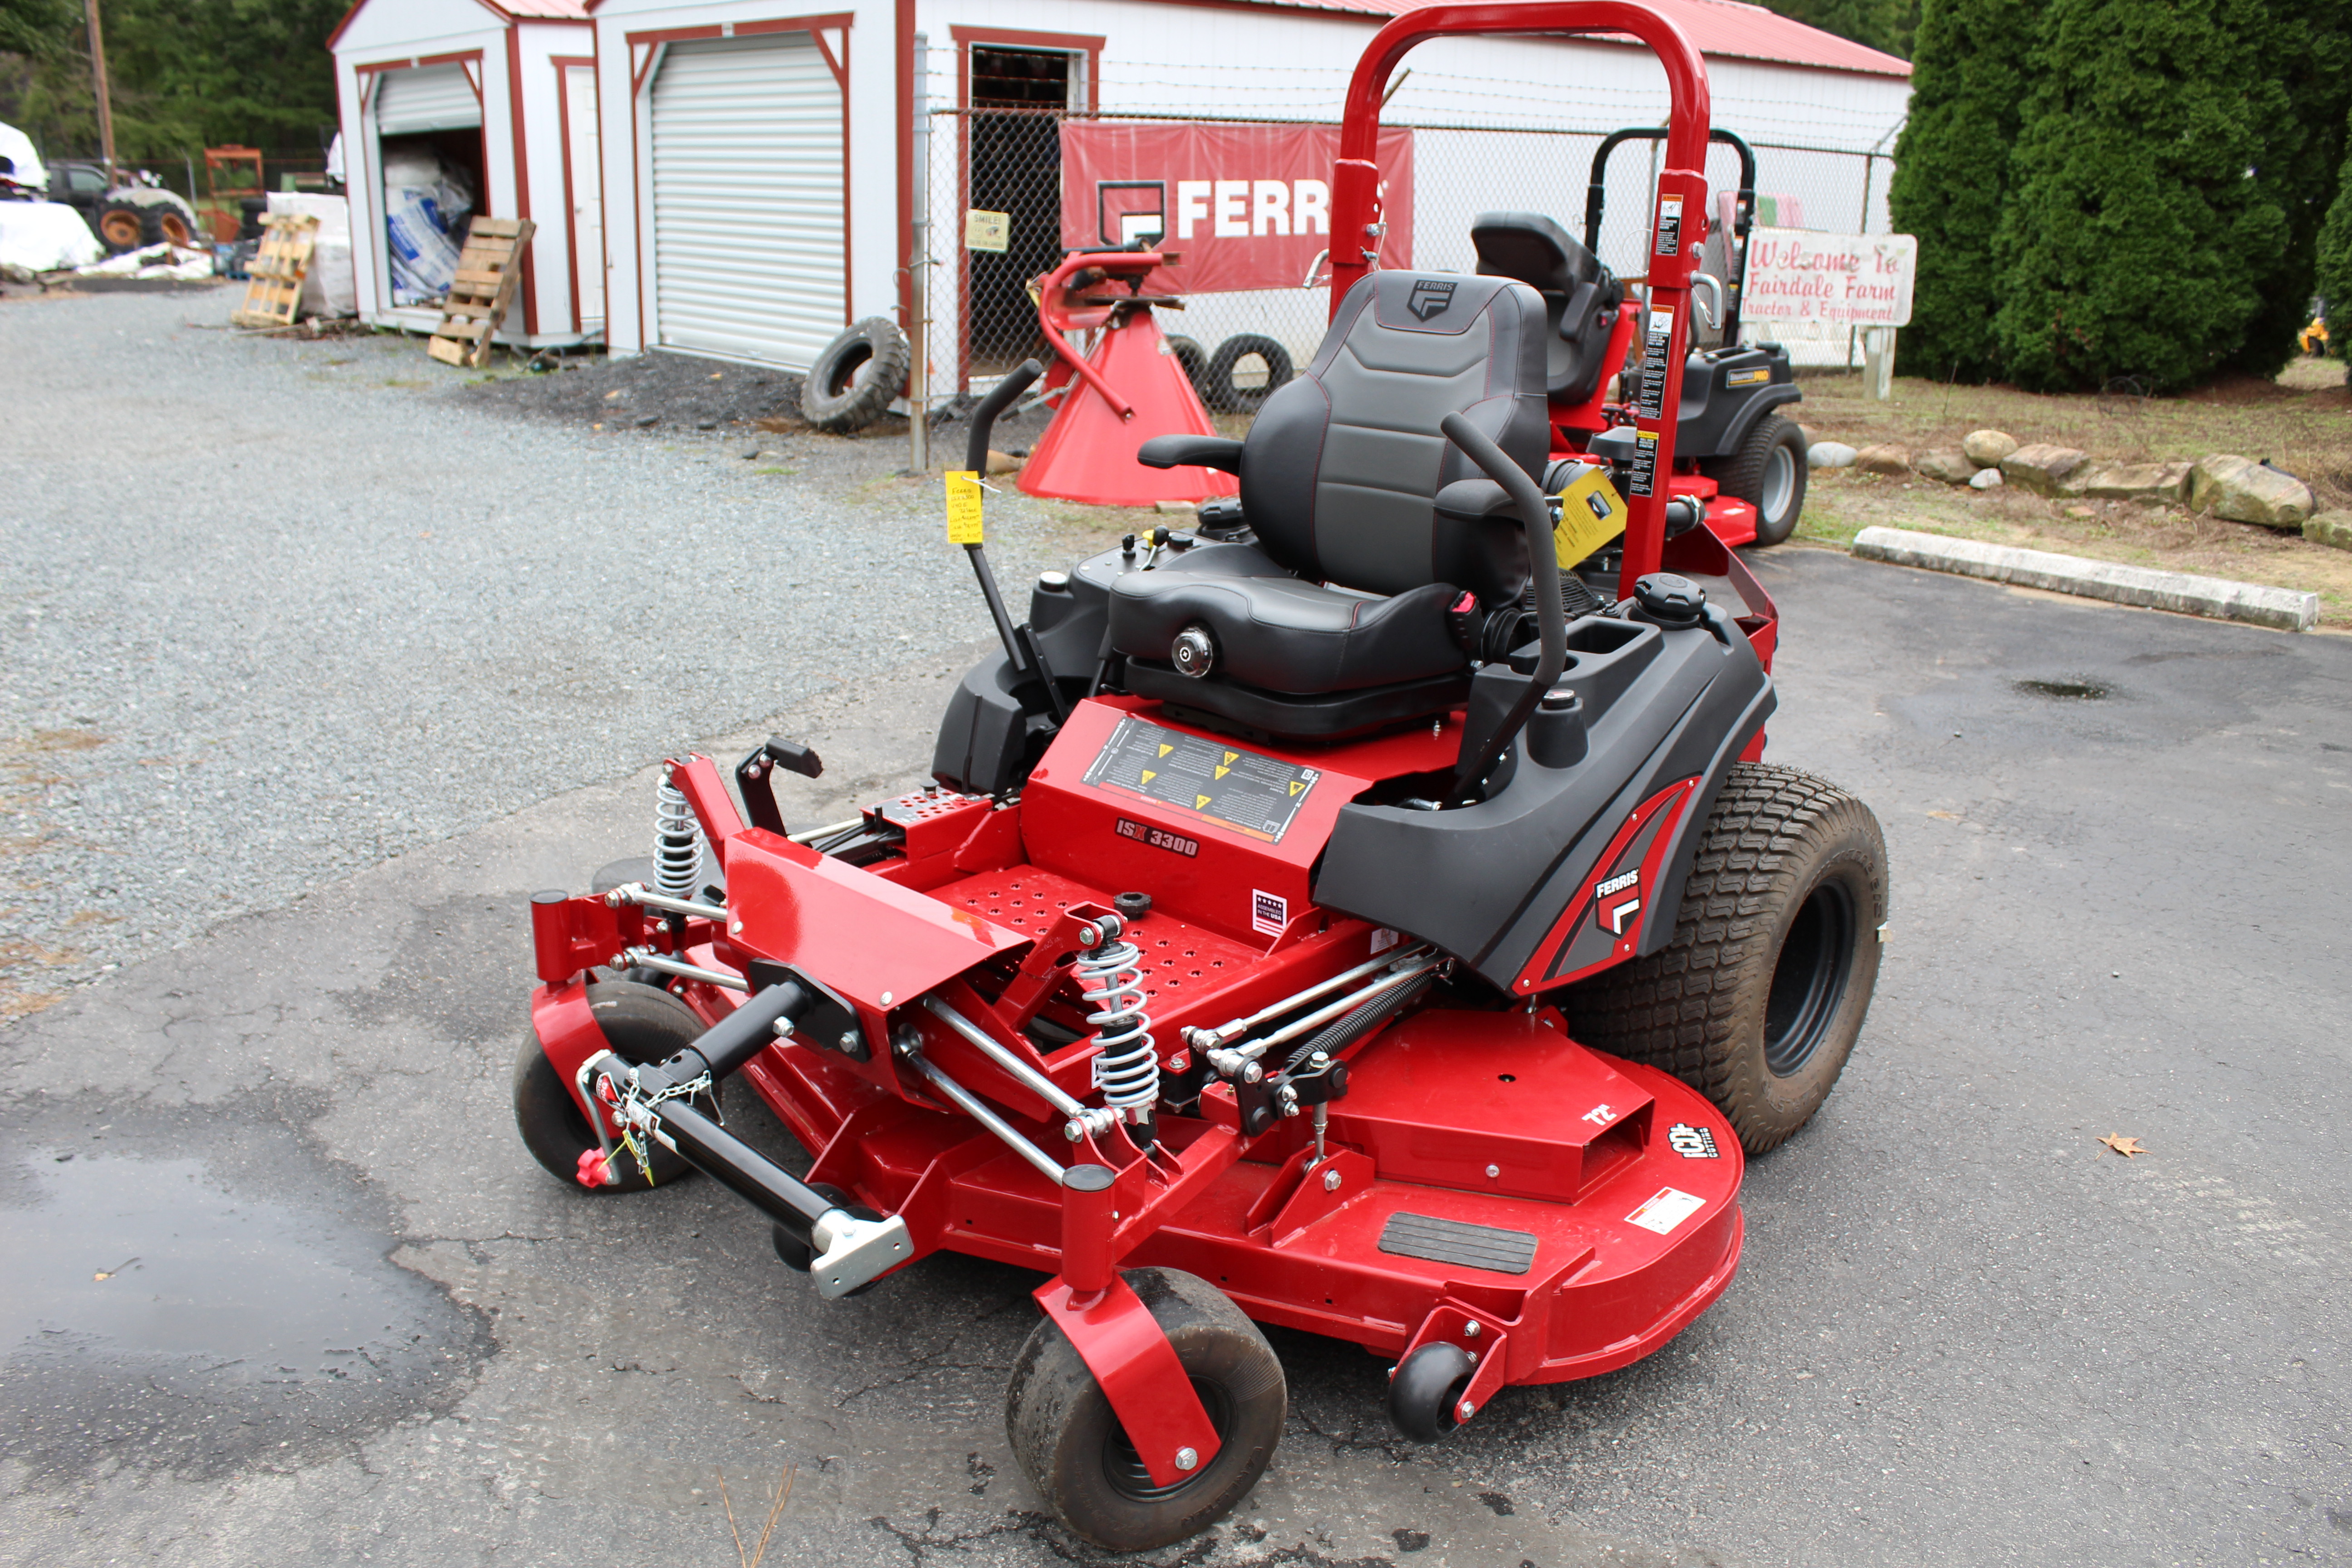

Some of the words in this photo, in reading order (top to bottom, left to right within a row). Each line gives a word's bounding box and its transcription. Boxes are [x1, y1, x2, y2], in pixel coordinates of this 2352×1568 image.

[974, 214, 1000, 224] SMILE!
[1751, 240, 1860, 272] Welcome
[1874, 245, 1899, 274] To
[1417, 281, 1454, 290] FERRIS
[1749, 271, 1833, 298] Fairdale
[1845, 275, 1895, 301] Farm
[1742, 297, 1792, 316] Tractor
[1800, 300, 1810, 316] &
[1820, 301, 1892, 322] Equipment
[1754, 369, 1769, 382] PRO
[1117, 819, 1147, 842] ISX
[1150, 830, 1198, 856] 3300
[1597, 869, 1638, 898] FERRIS
[1257, 904, 1282, 916] ASSEMBLED
[1270, 913, 1282, 921] USA
[1581, 1104, 1617, 1126] 72"
[1668, 1123, 1708, 1158] ICD+
[1699, 1127, 1719, 1158] CUTTING
